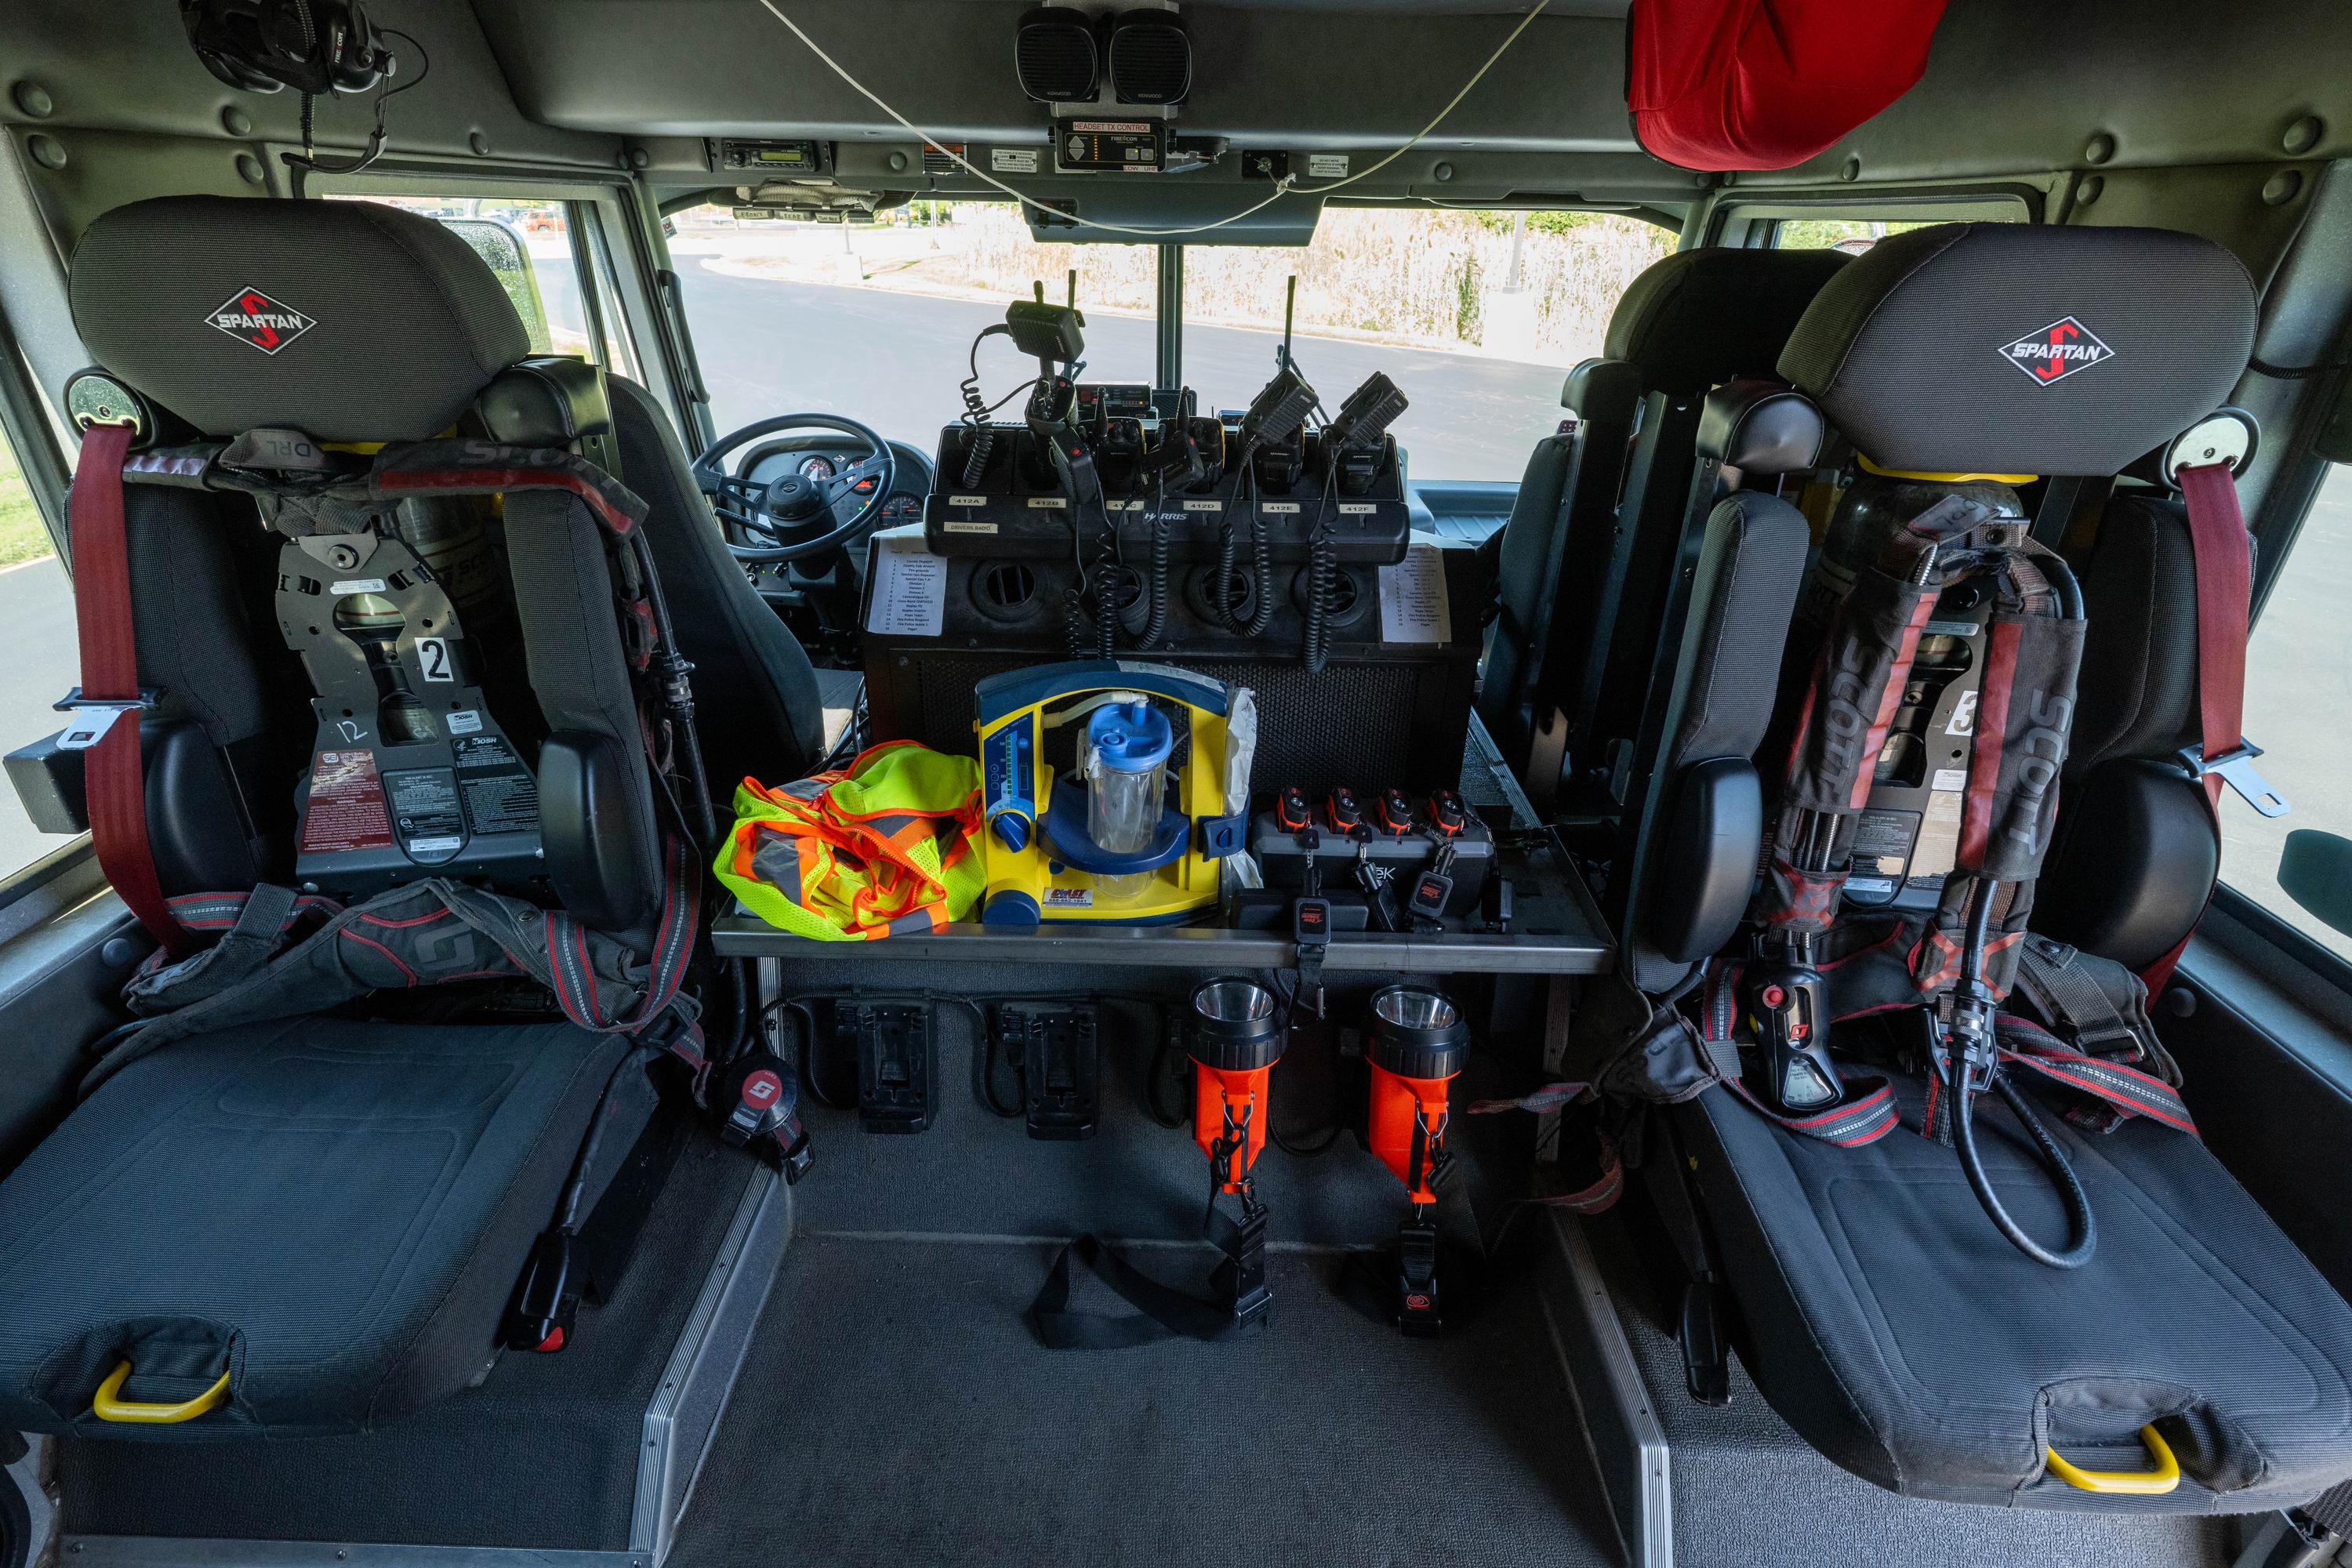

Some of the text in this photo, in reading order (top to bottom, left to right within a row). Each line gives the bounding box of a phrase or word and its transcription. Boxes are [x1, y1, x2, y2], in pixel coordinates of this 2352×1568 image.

[216, 314, 303, 329] SPARTAN
[2012, 343, 2101, 361] SPARTAN
[422, 640, 450, 679] 2
[336, 720, 368, 743] 12
